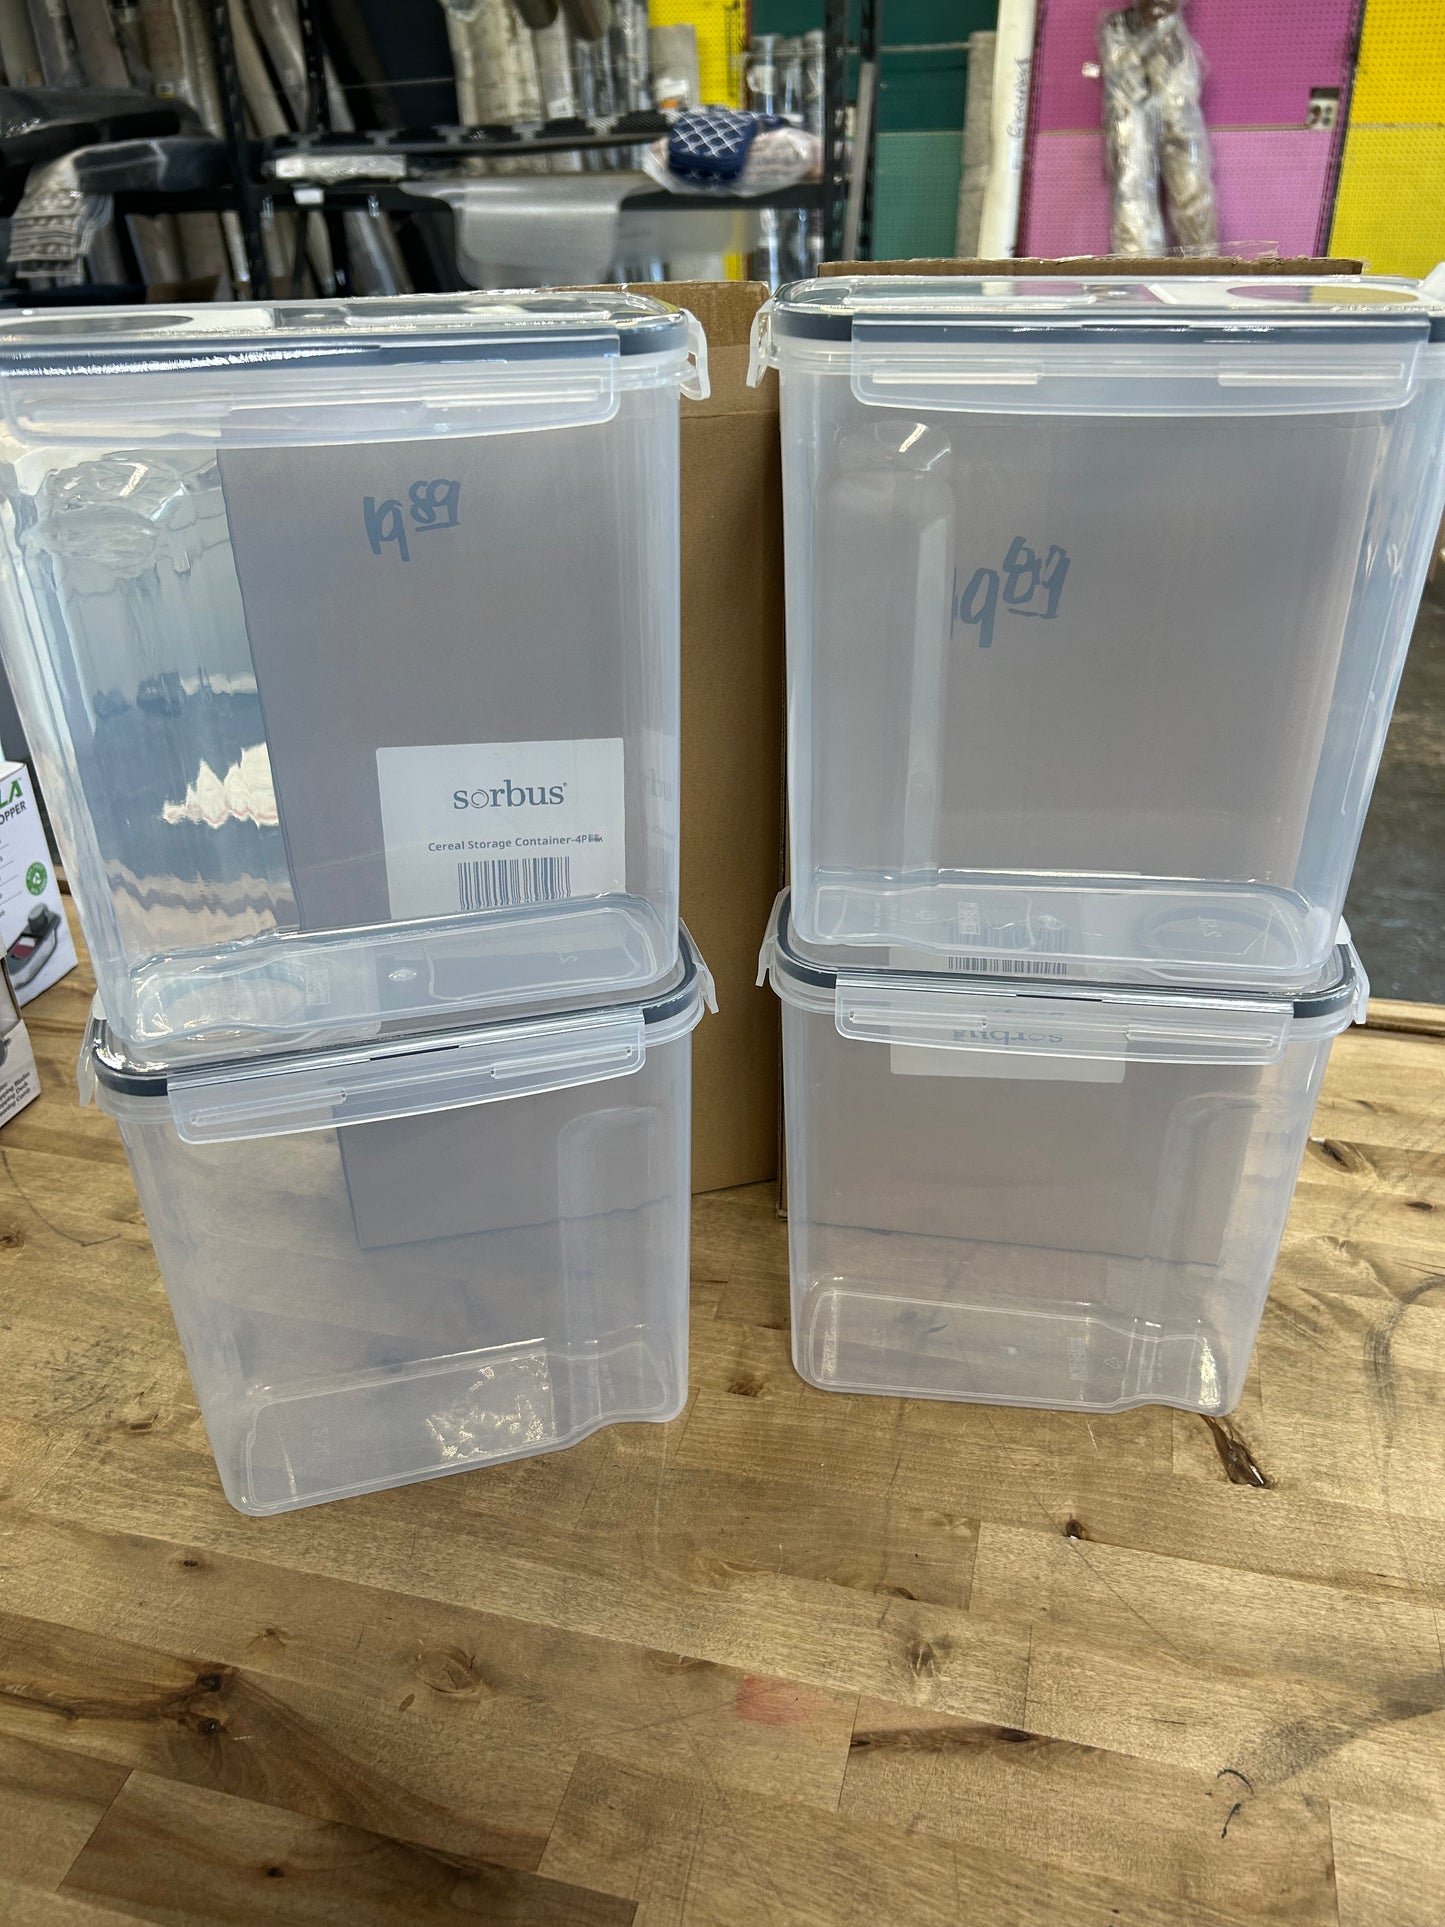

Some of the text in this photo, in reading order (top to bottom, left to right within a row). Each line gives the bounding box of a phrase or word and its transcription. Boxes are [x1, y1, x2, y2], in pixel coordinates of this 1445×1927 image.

[951, 535, 1071, 649] 989
[453, 779, 566, 810] sorbus
[428, 841, 465, 852] Cereal
[468, 839, 512, 851] Storage
